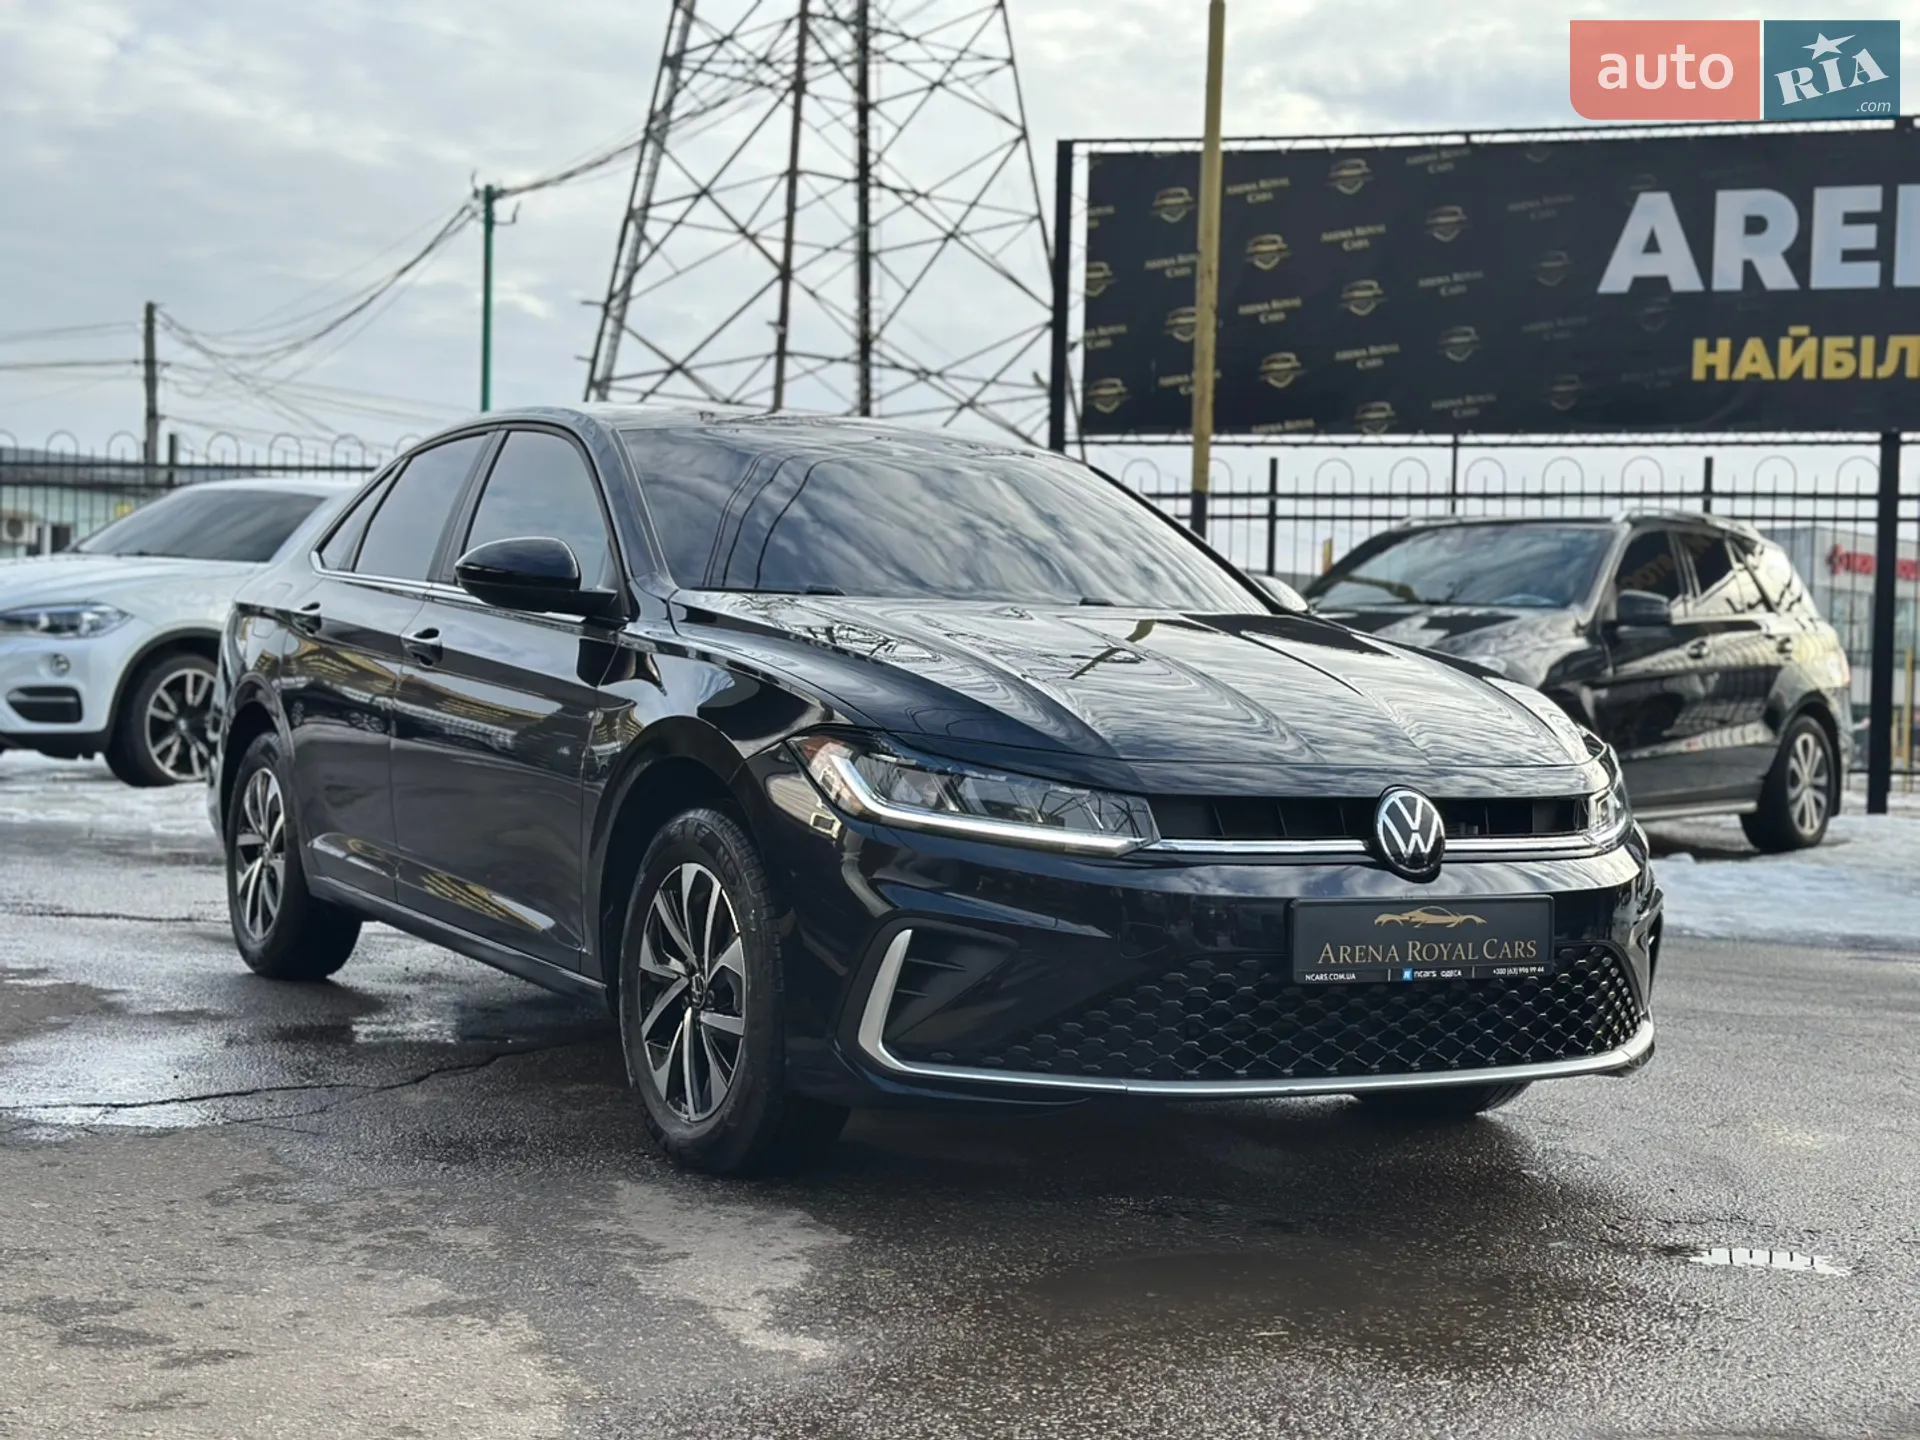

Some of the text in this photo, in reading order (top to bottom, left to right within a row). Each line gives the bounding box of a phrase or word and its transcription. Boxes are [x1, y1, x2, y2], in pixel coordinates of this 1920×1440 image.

[1317, 938, 1537, 964] ARENA ROYAL CARS
